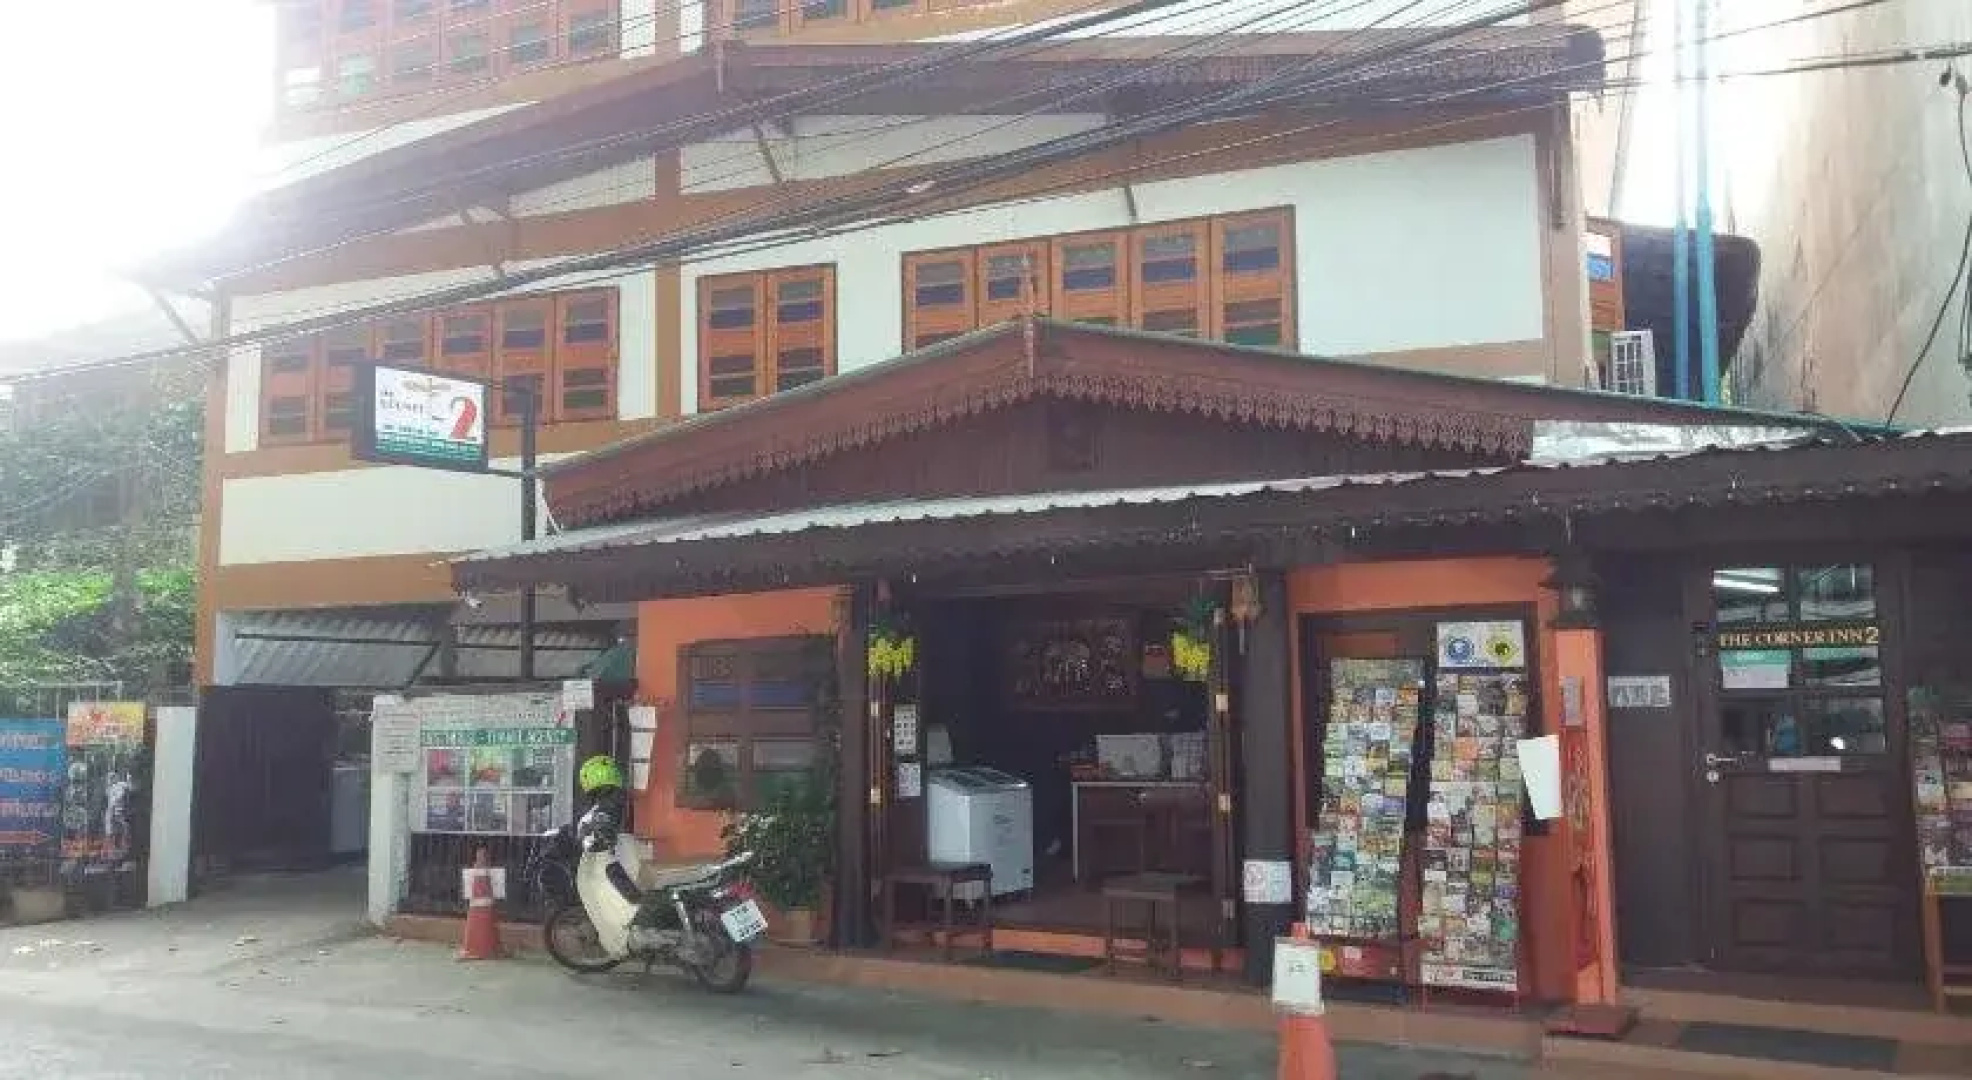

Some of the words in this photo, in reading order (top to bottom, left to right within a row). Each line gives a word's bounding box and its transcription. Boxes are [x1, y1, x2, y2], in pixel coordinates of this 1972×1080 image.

[1719, 632, 1750, 647] THE
[1755, 629, 1825, 645] CORNER
[1830, 628, 1863, 645] INN
[1865, 626, 1879, 644] 2
